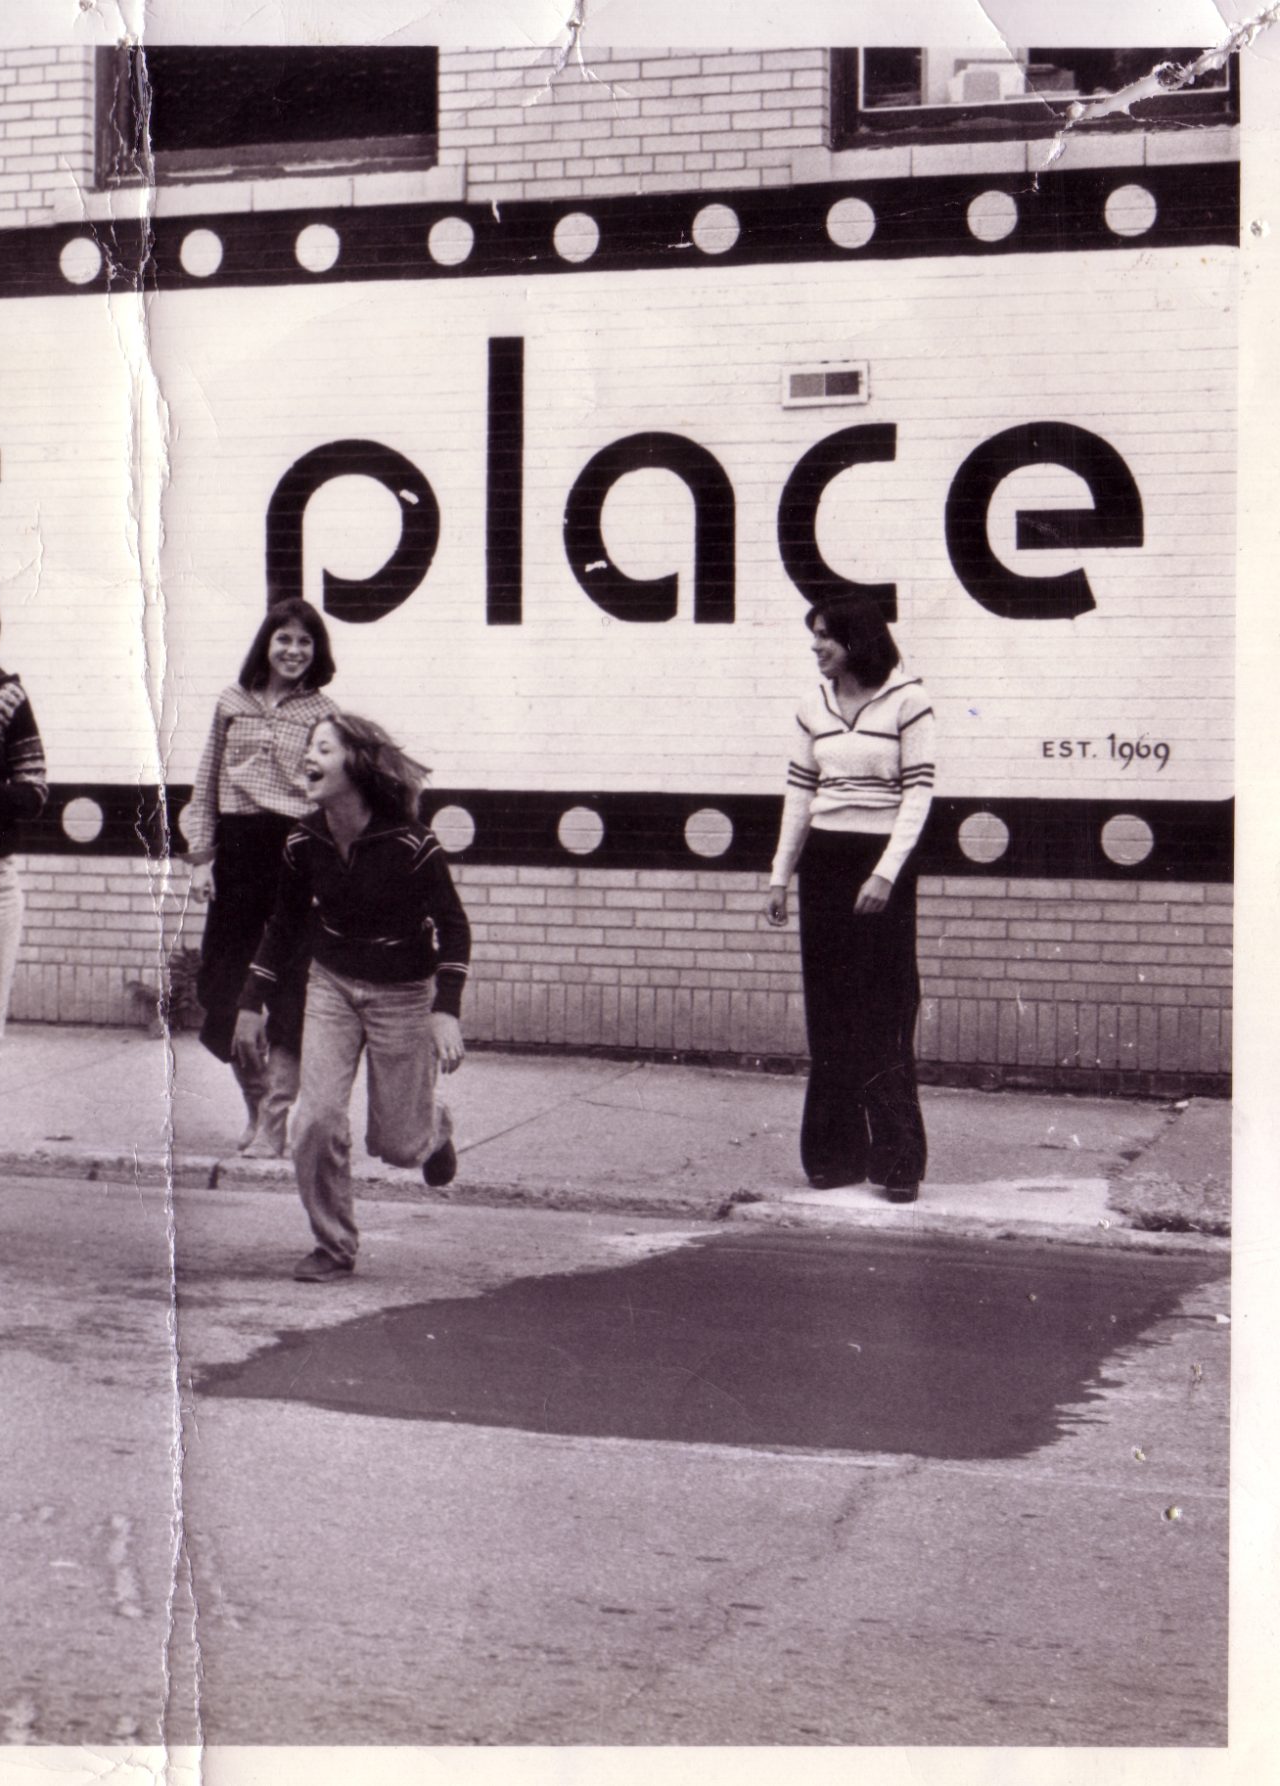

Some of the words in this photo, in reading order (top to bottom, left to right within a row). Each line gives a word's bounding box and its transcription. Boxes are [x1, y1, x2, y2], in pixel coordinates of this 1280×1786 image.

[266, 337, 1144, 625] place
[1042, 740, 1097, 759] EST.
[1106, 732, 1171, 773] 1969
